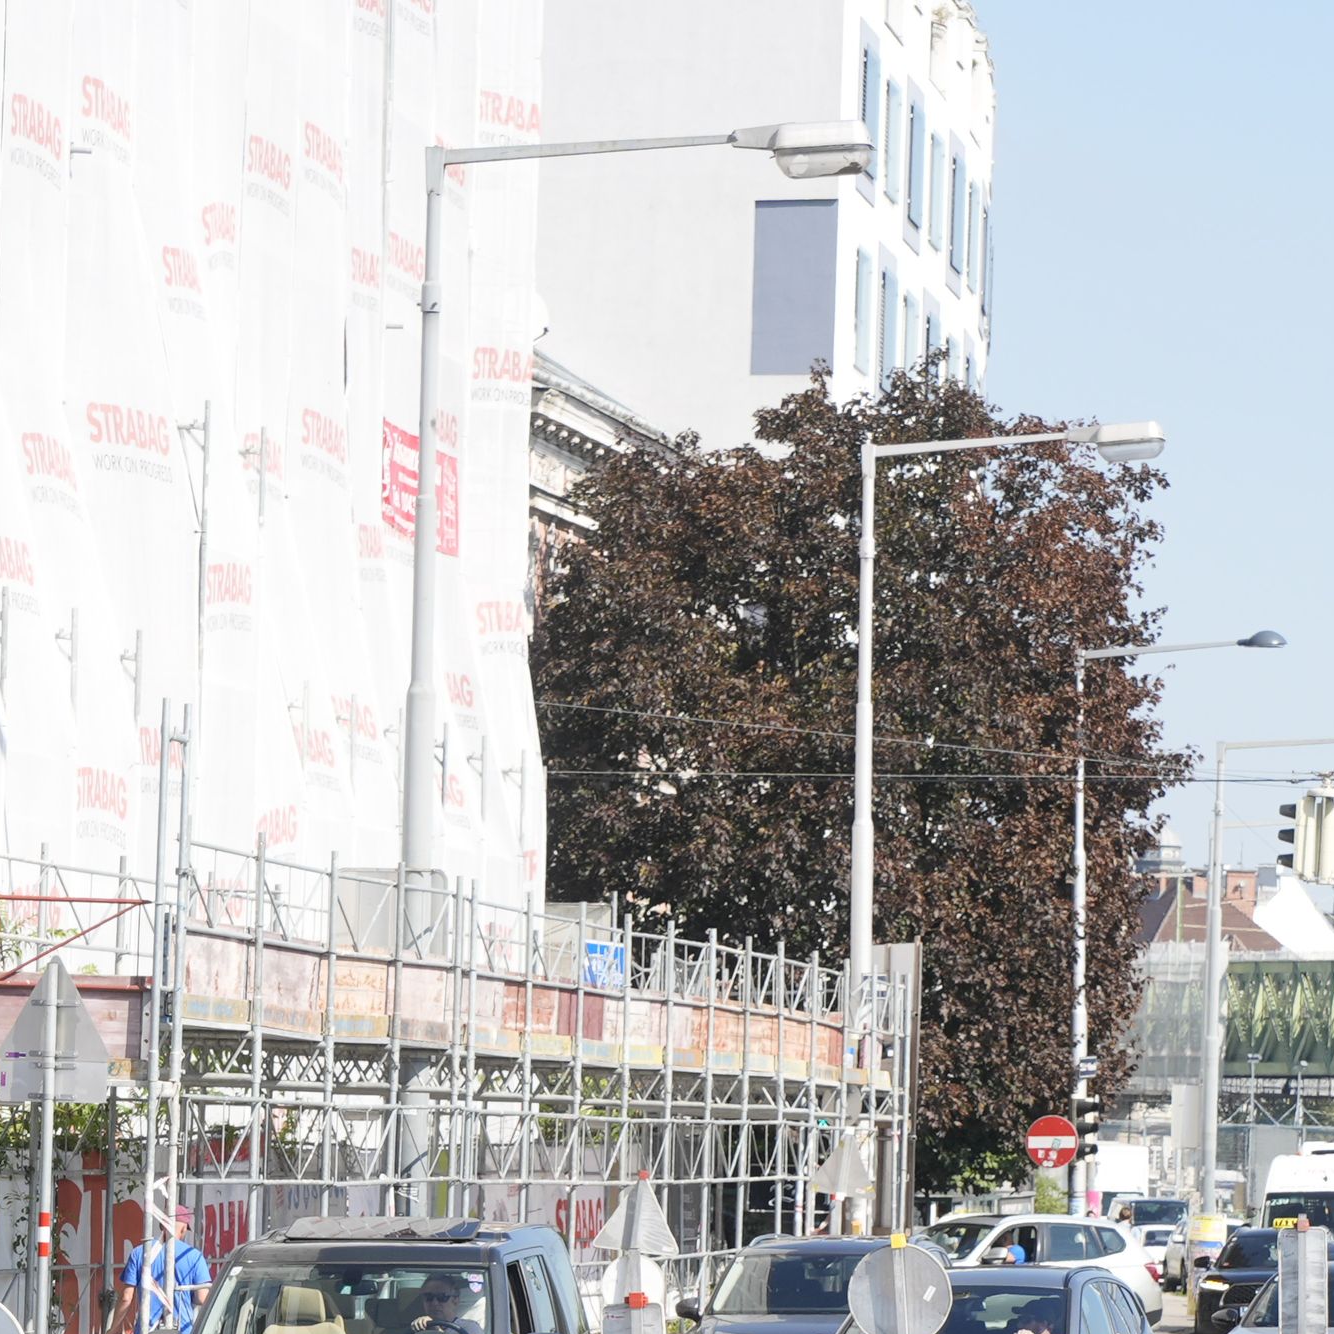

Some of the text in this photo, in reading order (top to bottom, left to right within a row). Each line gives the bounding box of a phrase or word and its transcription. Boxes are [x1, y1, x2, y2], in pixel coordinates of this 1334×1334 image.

[10, 92, 61, 162] STRABAG
[85, 401, 171, 457] STRABAG
[91, 453, 123, 471] WORK
[205, 562, 252, 607] STRABAG
